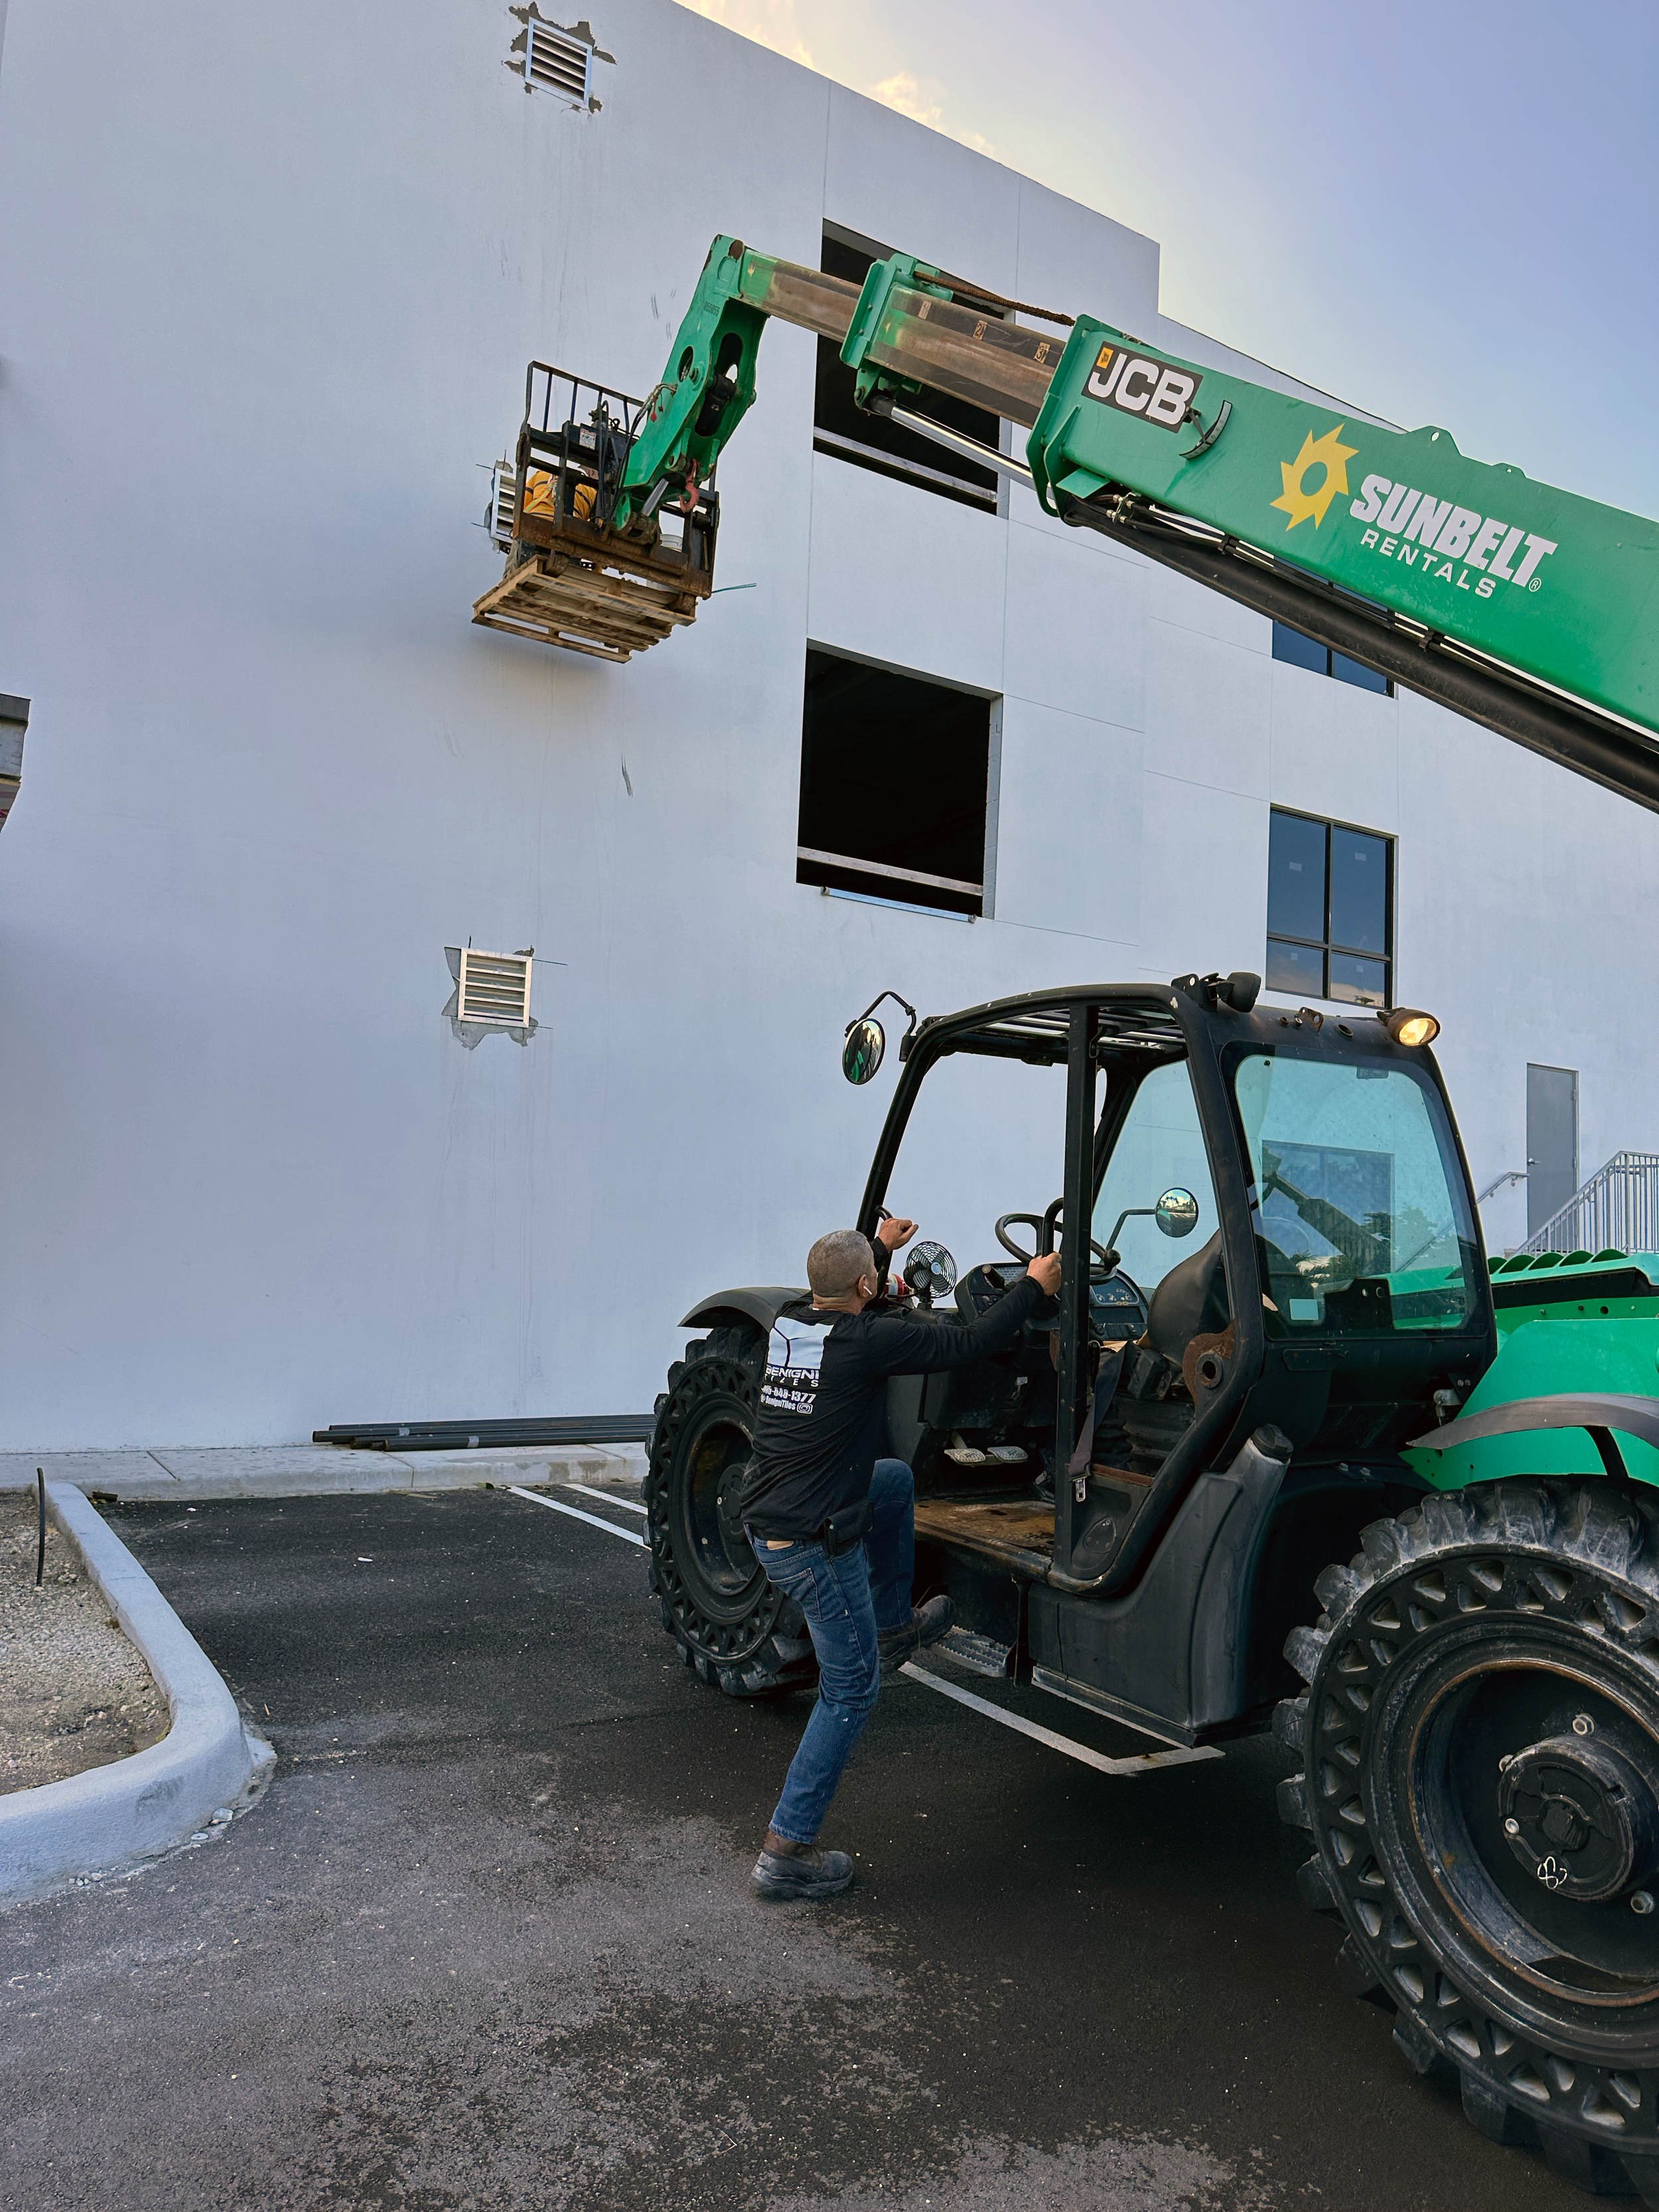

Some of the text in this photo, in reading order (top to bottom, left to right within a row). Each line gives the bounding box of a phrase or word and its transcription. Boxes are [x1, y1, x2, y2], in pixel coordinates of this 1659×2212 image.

[1088, 352, 1194, 425] JCB
[1360, 528, 1496, 599] RENTALS
[764, 1373, 820, 1387] TILES
[765, 1364, 820, 1380] BENIGNI
